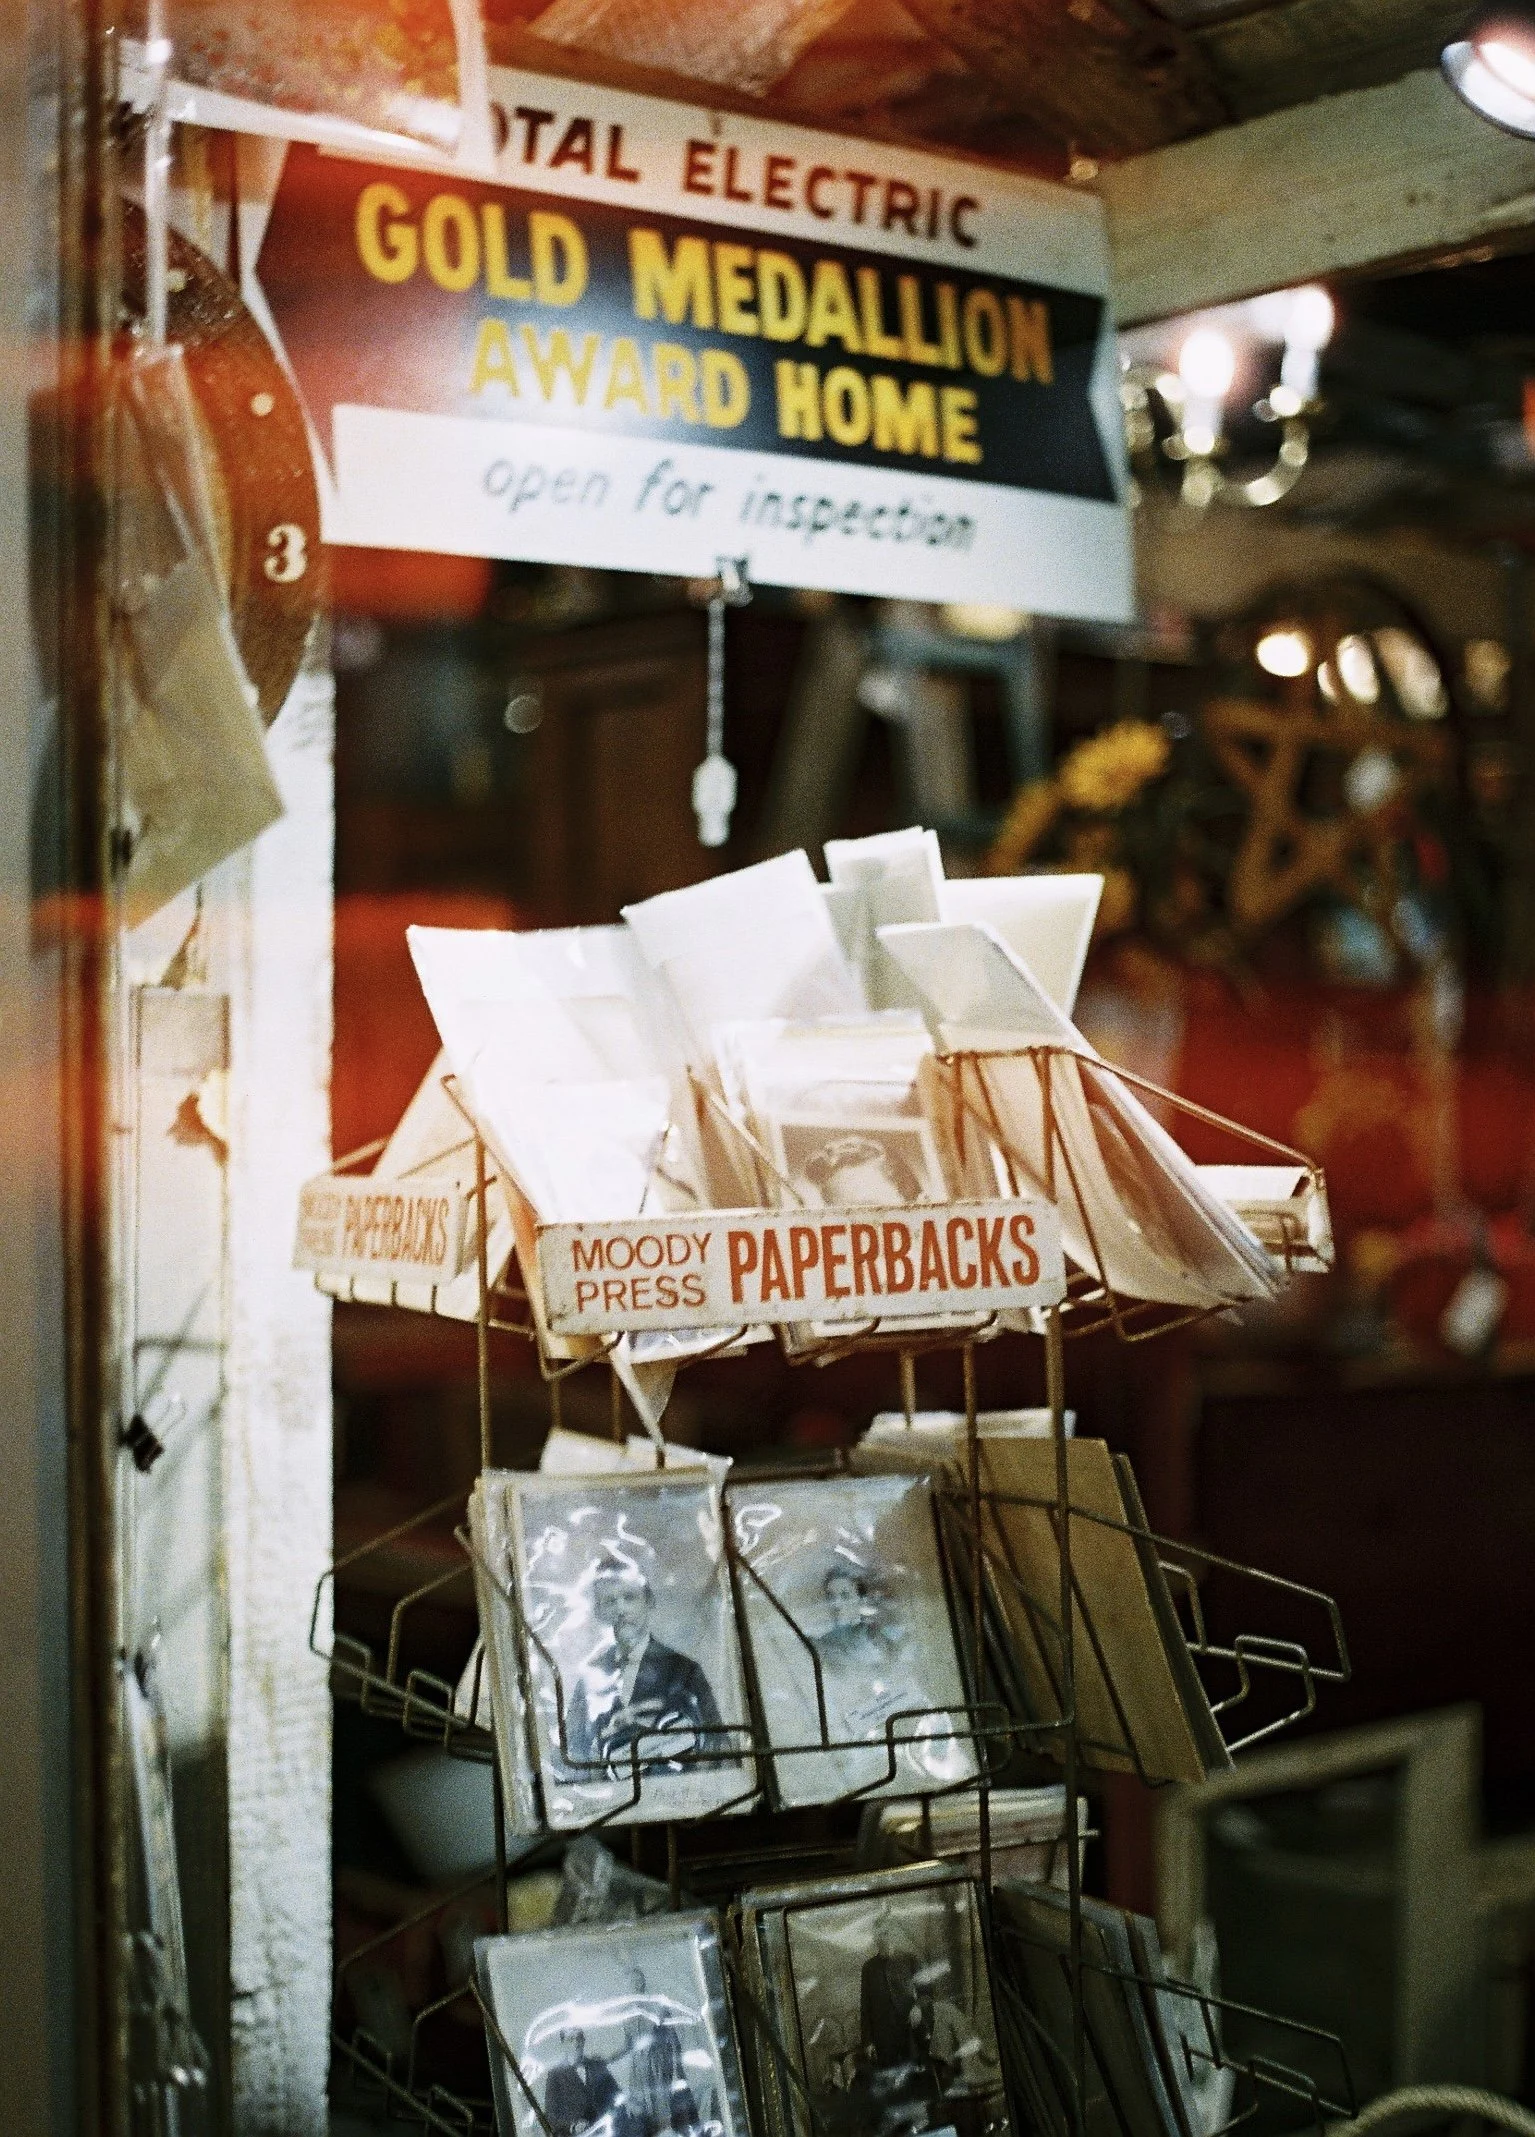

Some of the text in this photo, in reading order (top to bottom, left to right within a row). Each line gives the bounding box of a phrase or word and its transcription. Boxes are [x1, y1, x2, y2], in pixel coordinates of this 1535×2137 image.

[683, 139, 982, 249] ELECTRIC
[356, 183, 1055, 385] GOLD MEDALLION
[468, 317, 983, 466] AWARD HOME
[484, 457, 978, 549] open for inspection
[264, 523, 308, 582] 3
[571, 1232, 712, 1273] MOODY
[575, 1274, 707, 1314] PRESS
[727, 1214, 1041, 1305] PAPERBACKS
